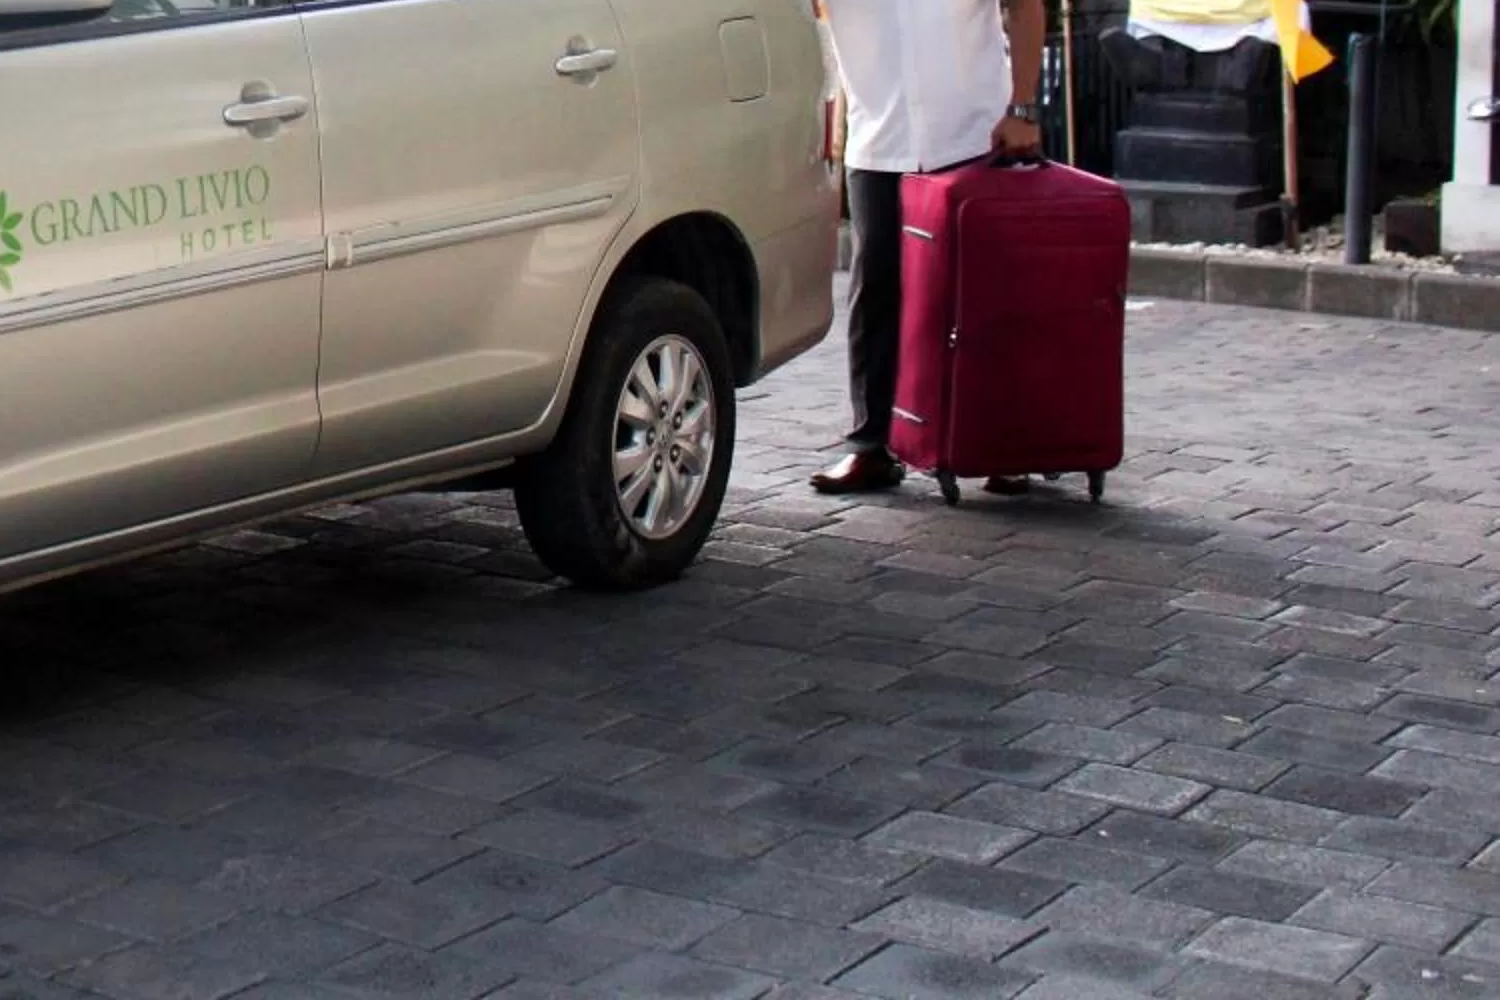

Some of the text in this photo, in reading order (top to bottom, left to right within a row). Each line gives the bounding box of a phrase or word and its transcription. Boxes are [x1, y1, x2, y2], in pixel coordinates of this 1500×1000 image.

[30, 164, 271, 246] GRAND LIVIO
[181, 217, 273, 258] HOTEL
